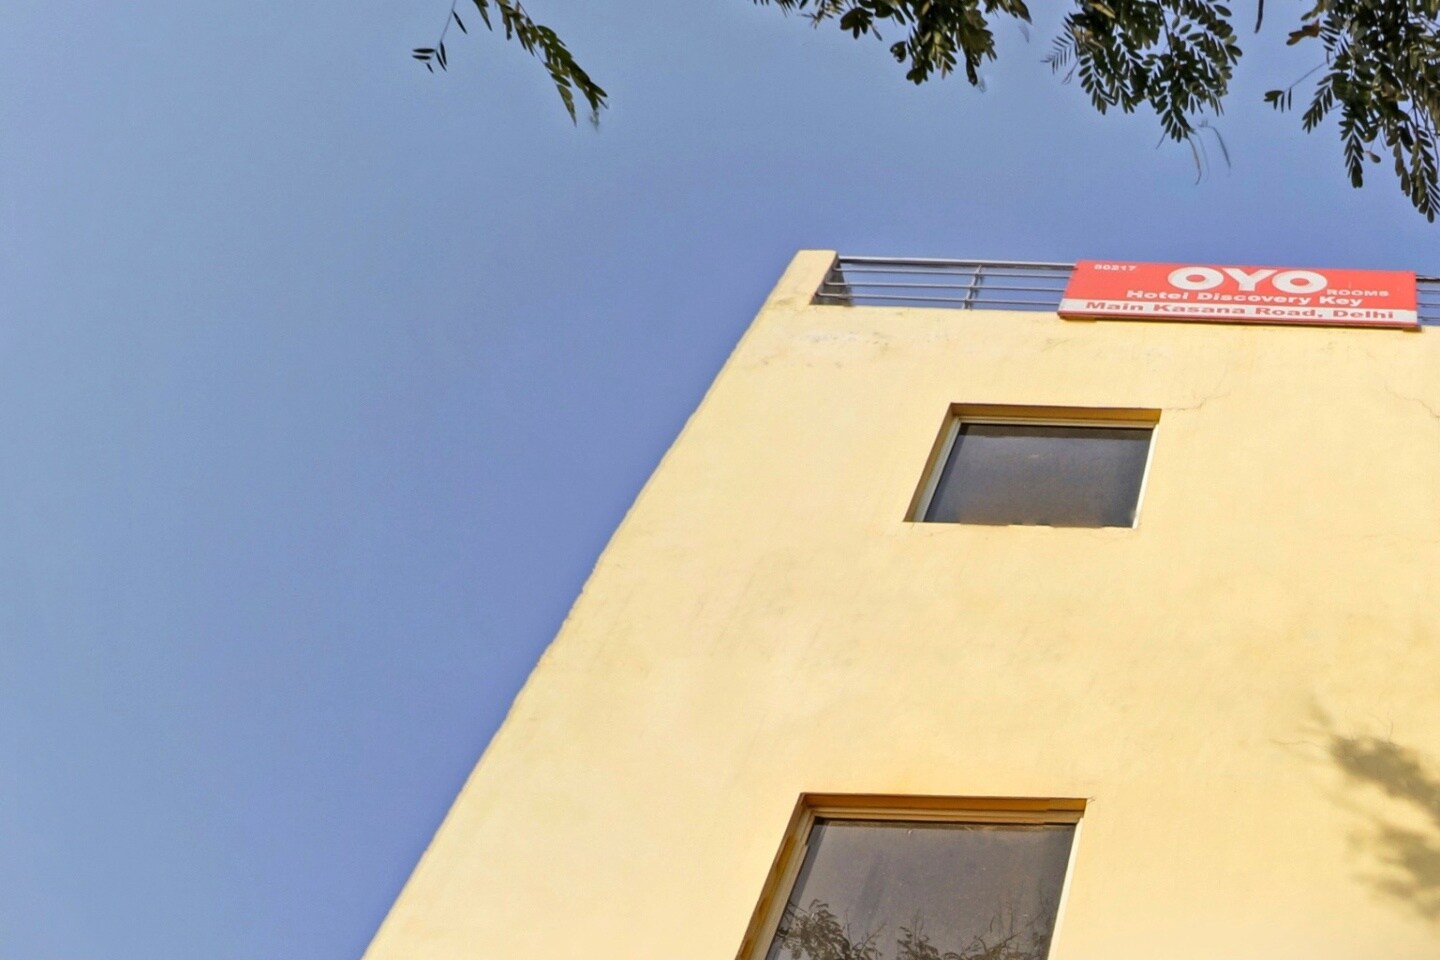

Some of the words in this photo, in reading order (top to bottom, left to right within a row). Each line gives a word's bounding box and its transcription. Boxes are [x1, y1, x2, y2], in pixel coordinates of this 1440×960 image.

[1167, 266, 1328, 293] OYO
[1126, 290, 1189, 300] Hotel
[1197, 291, 1311, 305] Discovery
[1319, 296, 1363, 307] Key
[1326, 288, 1390, 297] ROOMS
[1086, 302, 1144, 311] Main
[1153, 304, 1246, 314] Kasana
[1255, 307, 1324, 318] Road,
[1333, 310, 1394, 319] Delhi
